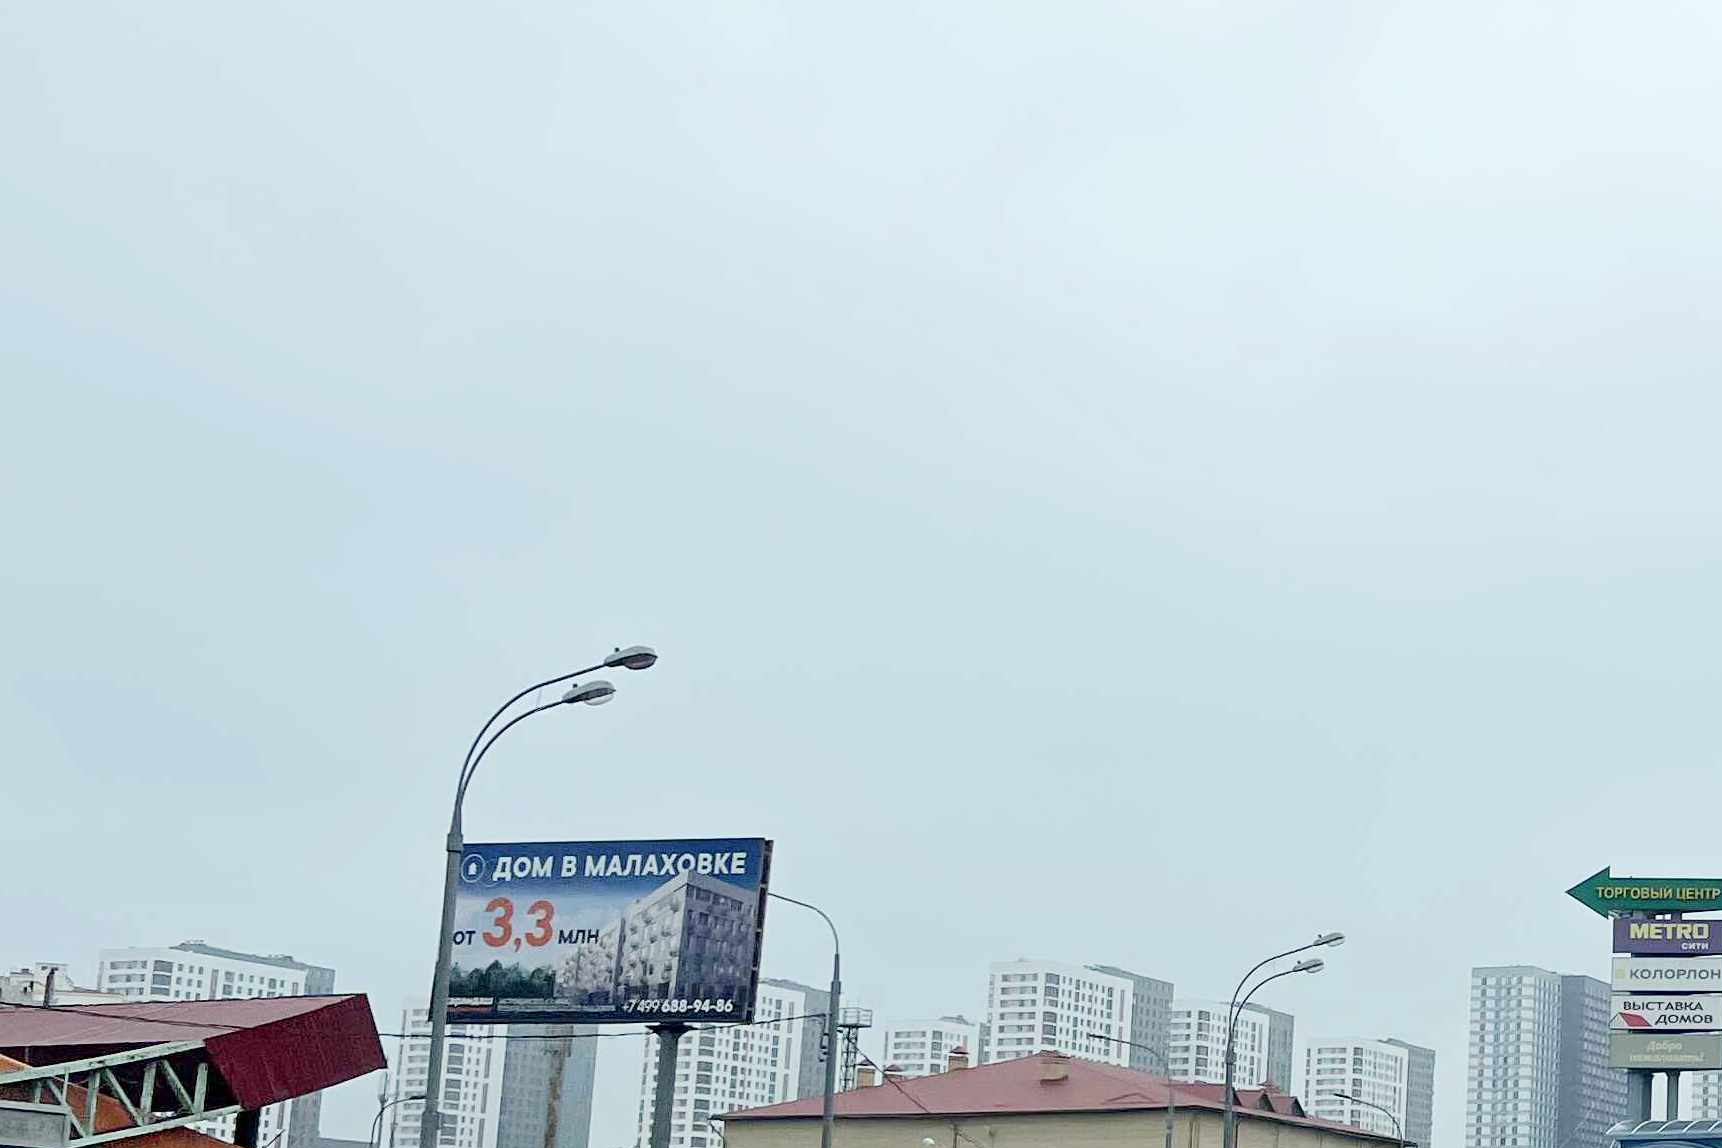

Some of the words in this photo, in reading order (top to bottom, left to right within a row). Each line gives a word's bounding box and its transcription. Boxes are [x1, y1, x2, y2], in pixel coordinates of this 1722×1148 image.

[492, 855, 553, 881] ДОМ
[561, 855, 577, 877] В
[584, 852, 747, 877] МАЛАХОВКЕ
[1596, 886, 1673, 900] ТОРГОВЫЙ
[1676, 887, 1721, 902] ЦЕНТР
[482, 896, 555, 952] 3,3
[1630, 923, 1710, 940] METRO
[1630, 968, 1721, 980] КОЛОРЛОН
[1623, 1001, 1704, 1011] ВЫСТАВКА
[1655, 1014, 1713, 1026] ДОМОВ
[1647, 1040, 1683, 1054] Добро
